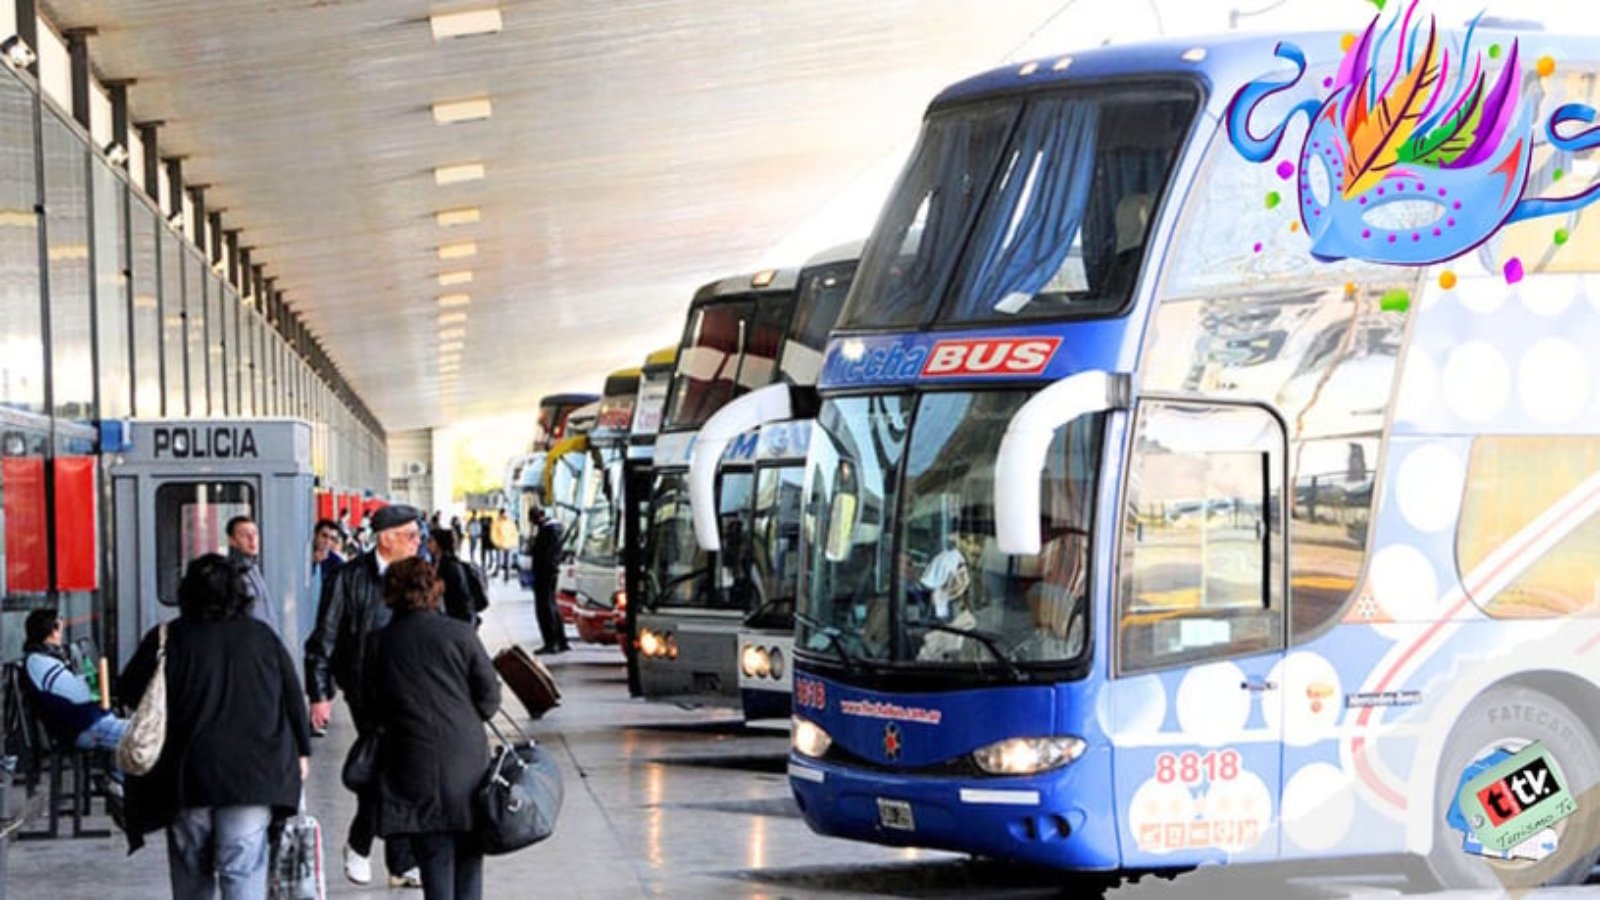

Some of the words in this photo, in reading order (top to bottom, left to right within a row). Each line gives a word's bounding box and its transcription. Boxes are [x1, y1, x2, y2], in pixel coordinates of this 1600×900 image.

[926, 341, 1051, 374] BUS
[154, 427, 258, 458] POLICIA
[1156, 750, 1240, 784] 8818
